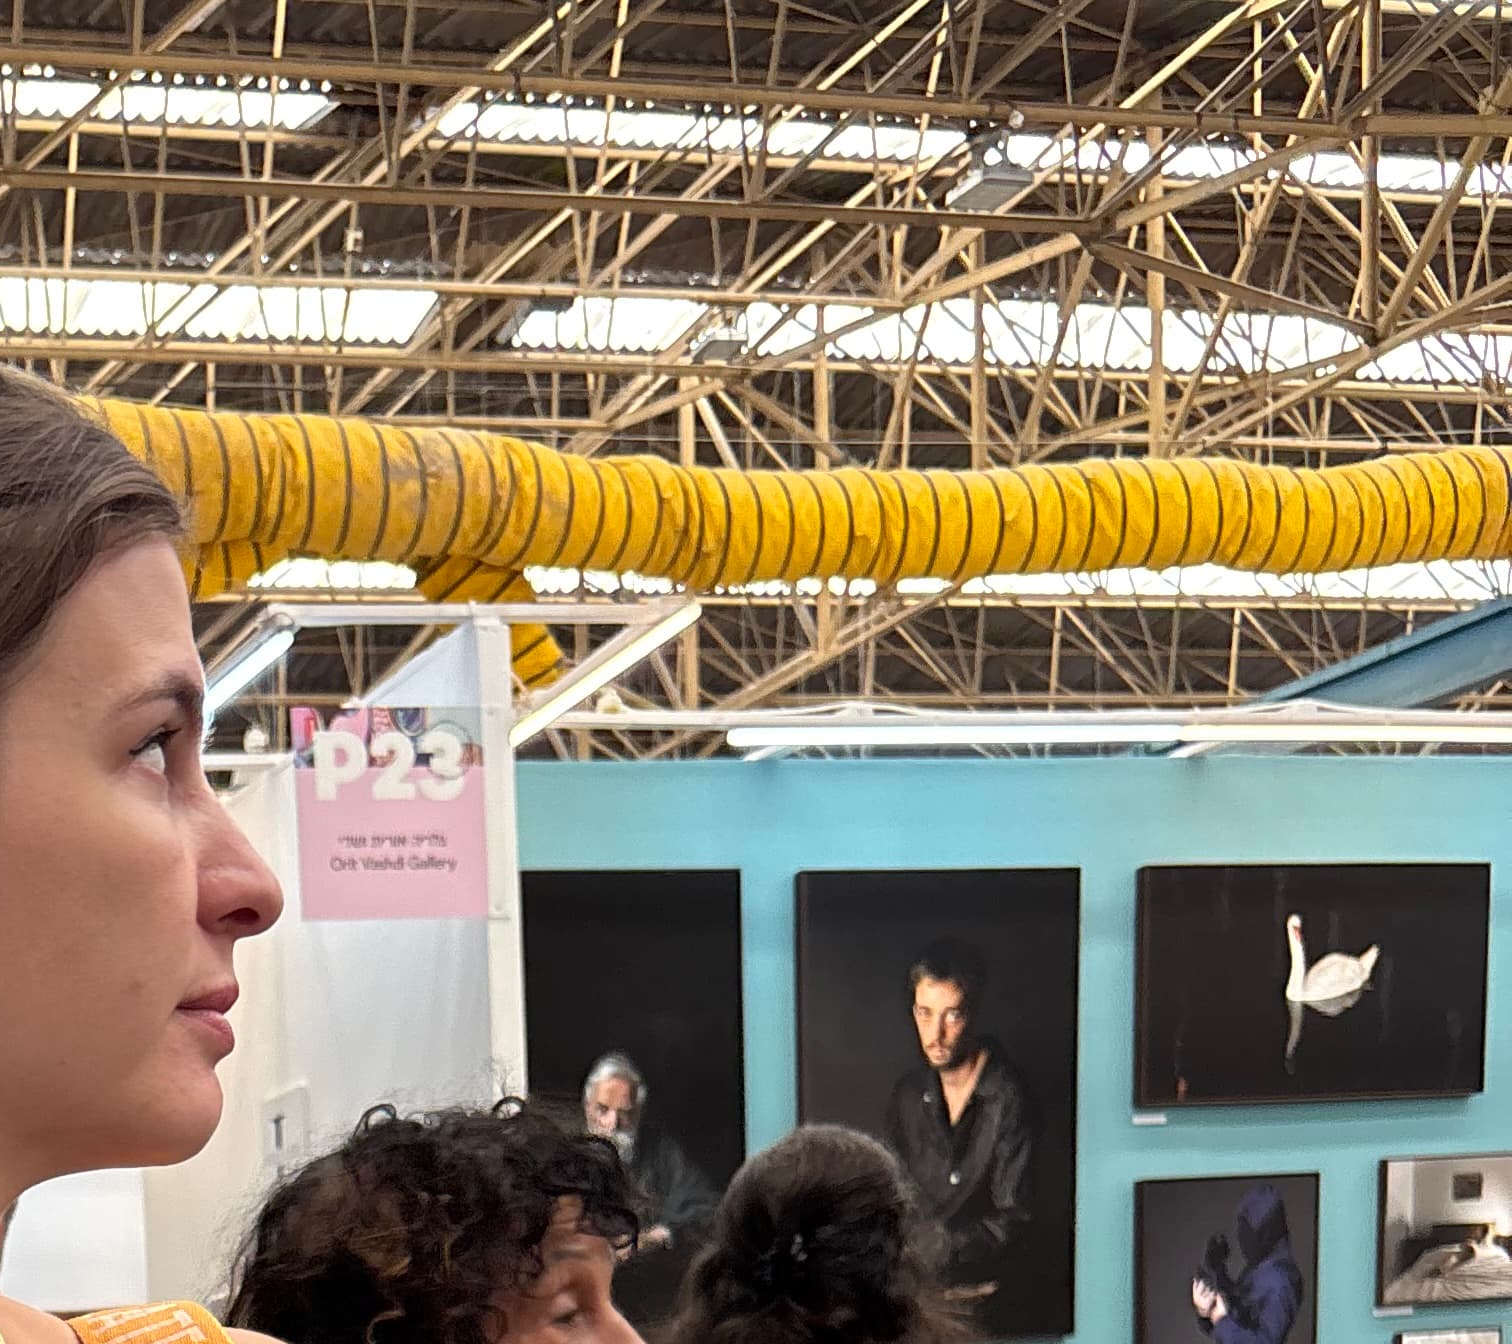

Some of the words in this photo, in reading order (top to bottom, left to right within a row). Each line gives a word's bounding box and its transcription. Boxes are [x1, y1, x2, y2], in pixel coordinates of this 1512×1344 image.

[313, 730, 466, 801] P23
[329, 856, 358, 872] Orit
[407, 854, 458, 873] Gallery
